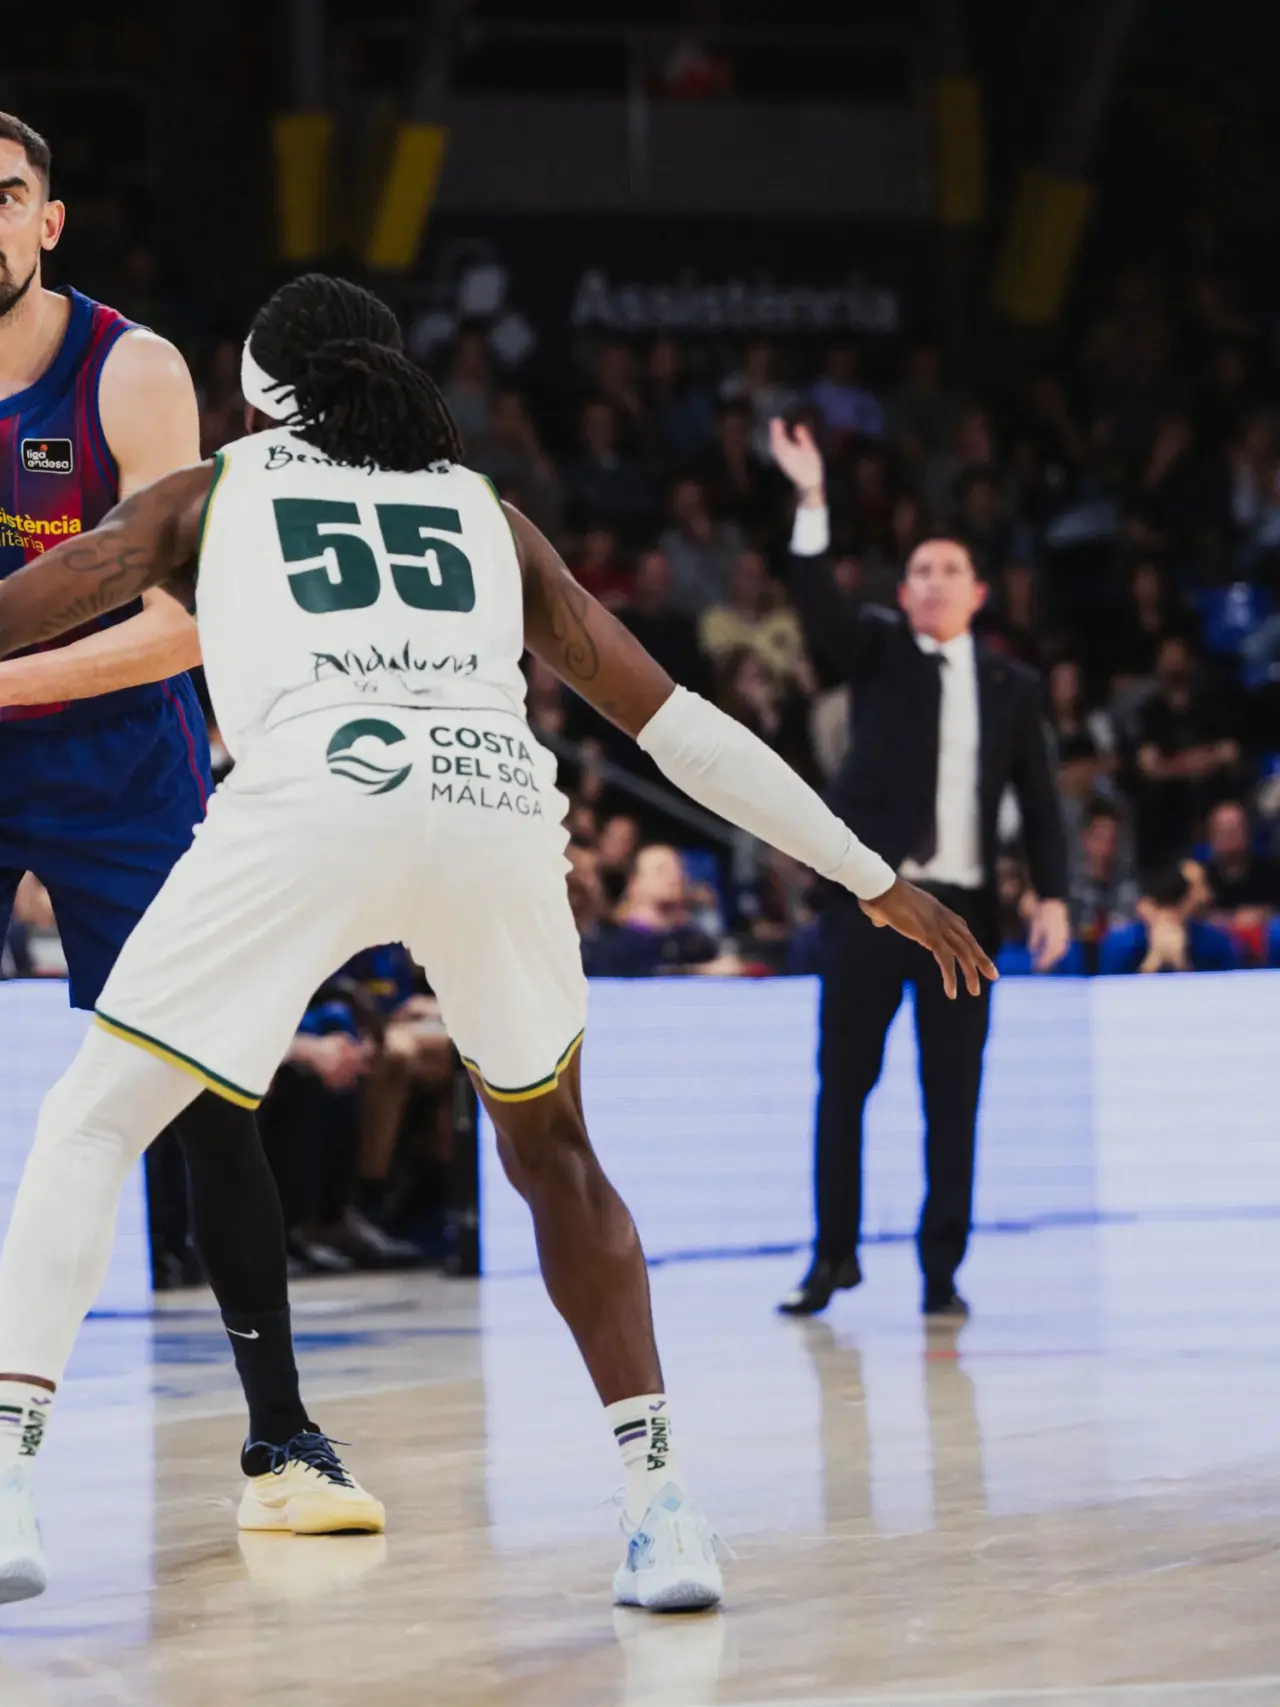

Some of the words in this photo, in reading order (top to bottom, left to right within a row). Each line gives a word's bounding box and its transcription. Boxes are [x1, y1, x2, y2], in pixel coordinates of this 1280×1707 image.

[26, 449, 46, 460] liga
[27, 459, 69, 469] endesa
[272, 498, 475, 614] 55
[429, 726, 535, 767] COSTA
[431, 755, 491, 779] DEL
[498, 763, 541, 793] SOL
[431, 779, 544, 820] MÁLAGA
